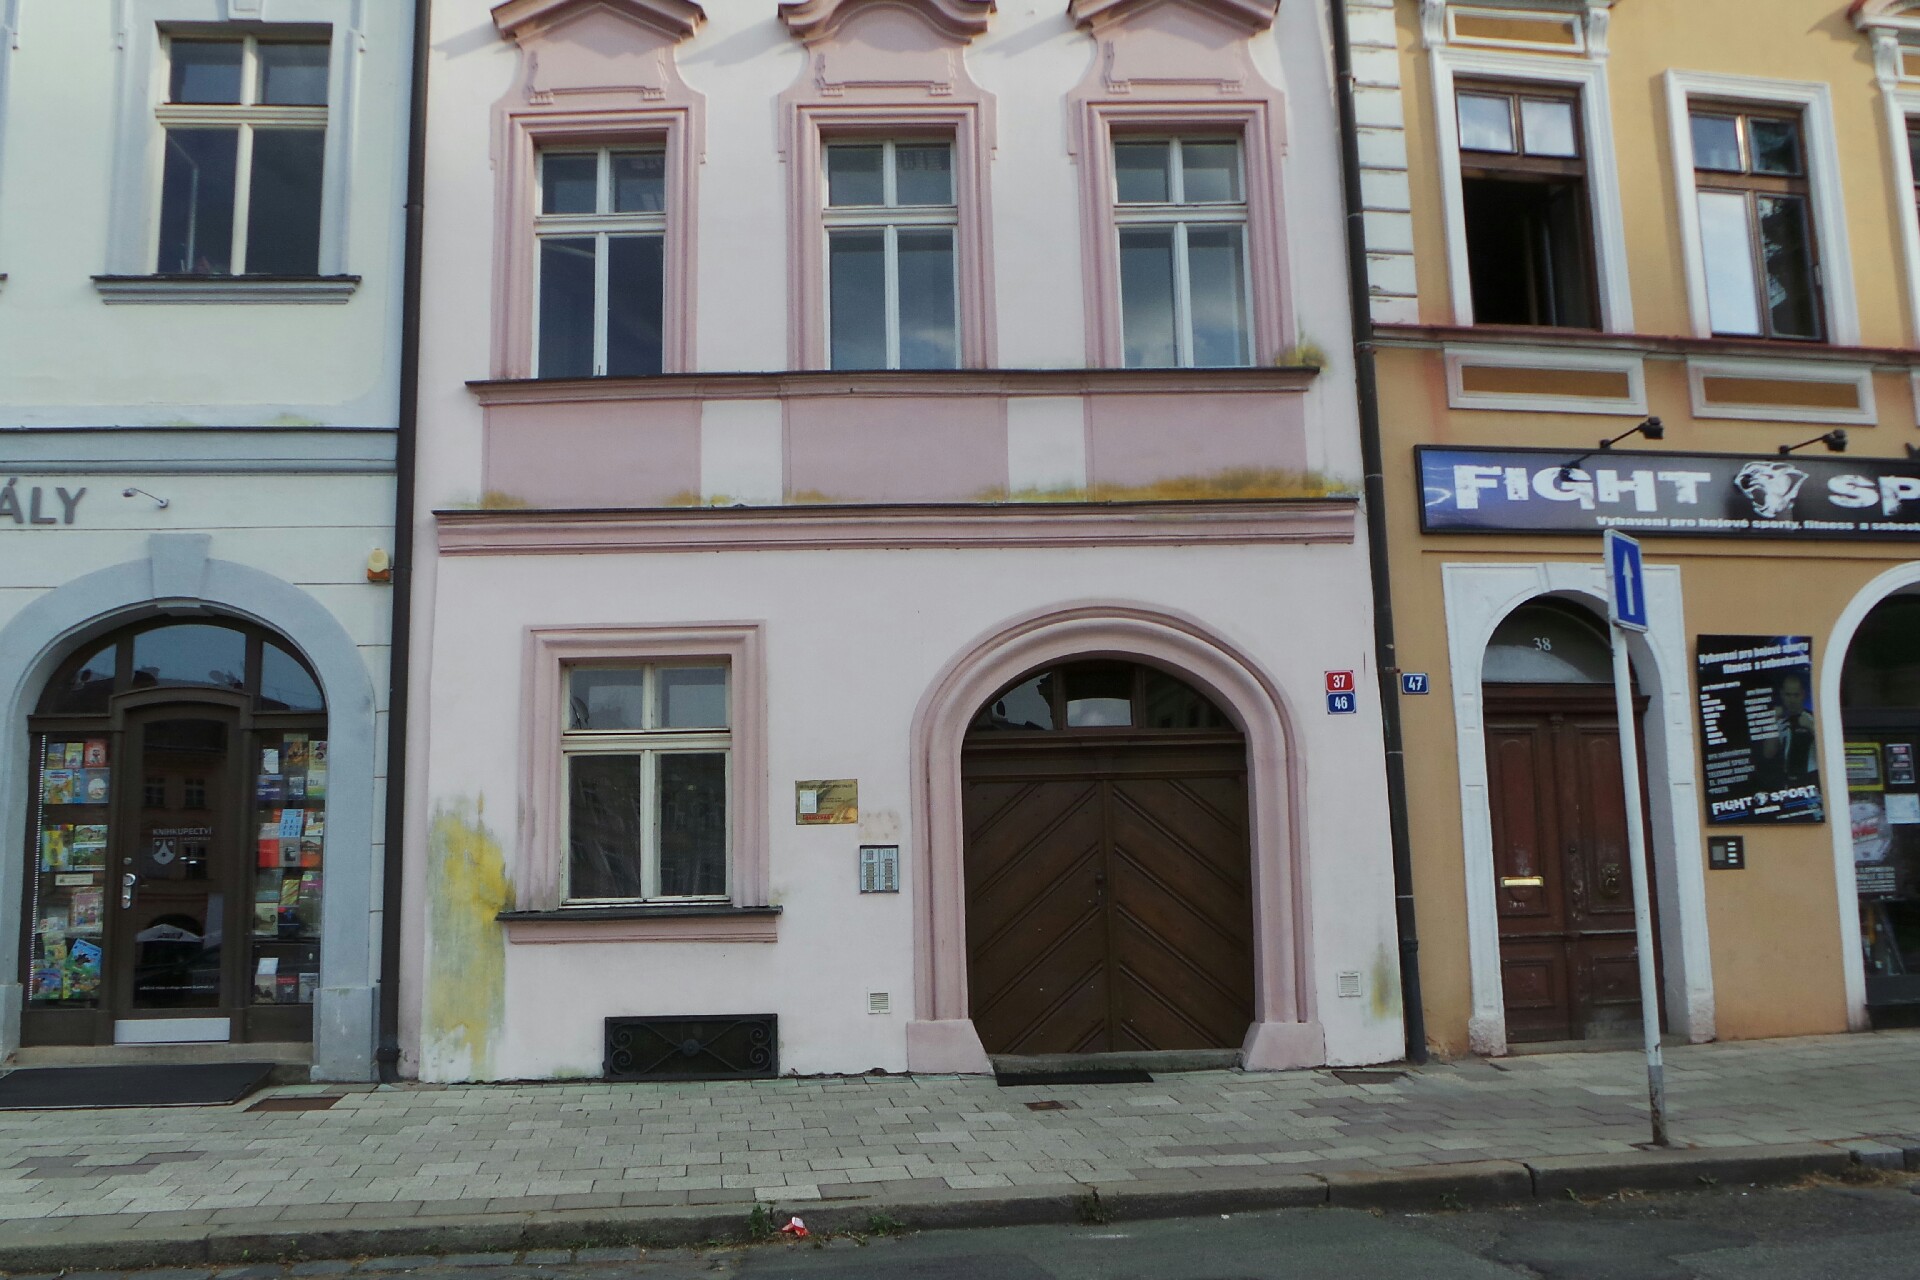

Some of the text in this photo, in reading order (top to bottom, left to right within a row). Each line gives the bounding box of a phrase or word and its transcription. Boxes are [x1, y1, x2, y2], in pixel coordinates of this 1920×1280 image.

[1453, 465, 1711, 512] FIGHT
[0, 477, 87, 524] ÁLY
[1532, 637, 1552, 651] 38
[1333, 674, 1346, 688] 37
[1408, 676, 1422, 691] 47
[1334, 696, 1348, 709] 46
[1711, 796, 1753, 816] FIGHT
[1769, 784, 1818, 803] SPORT
